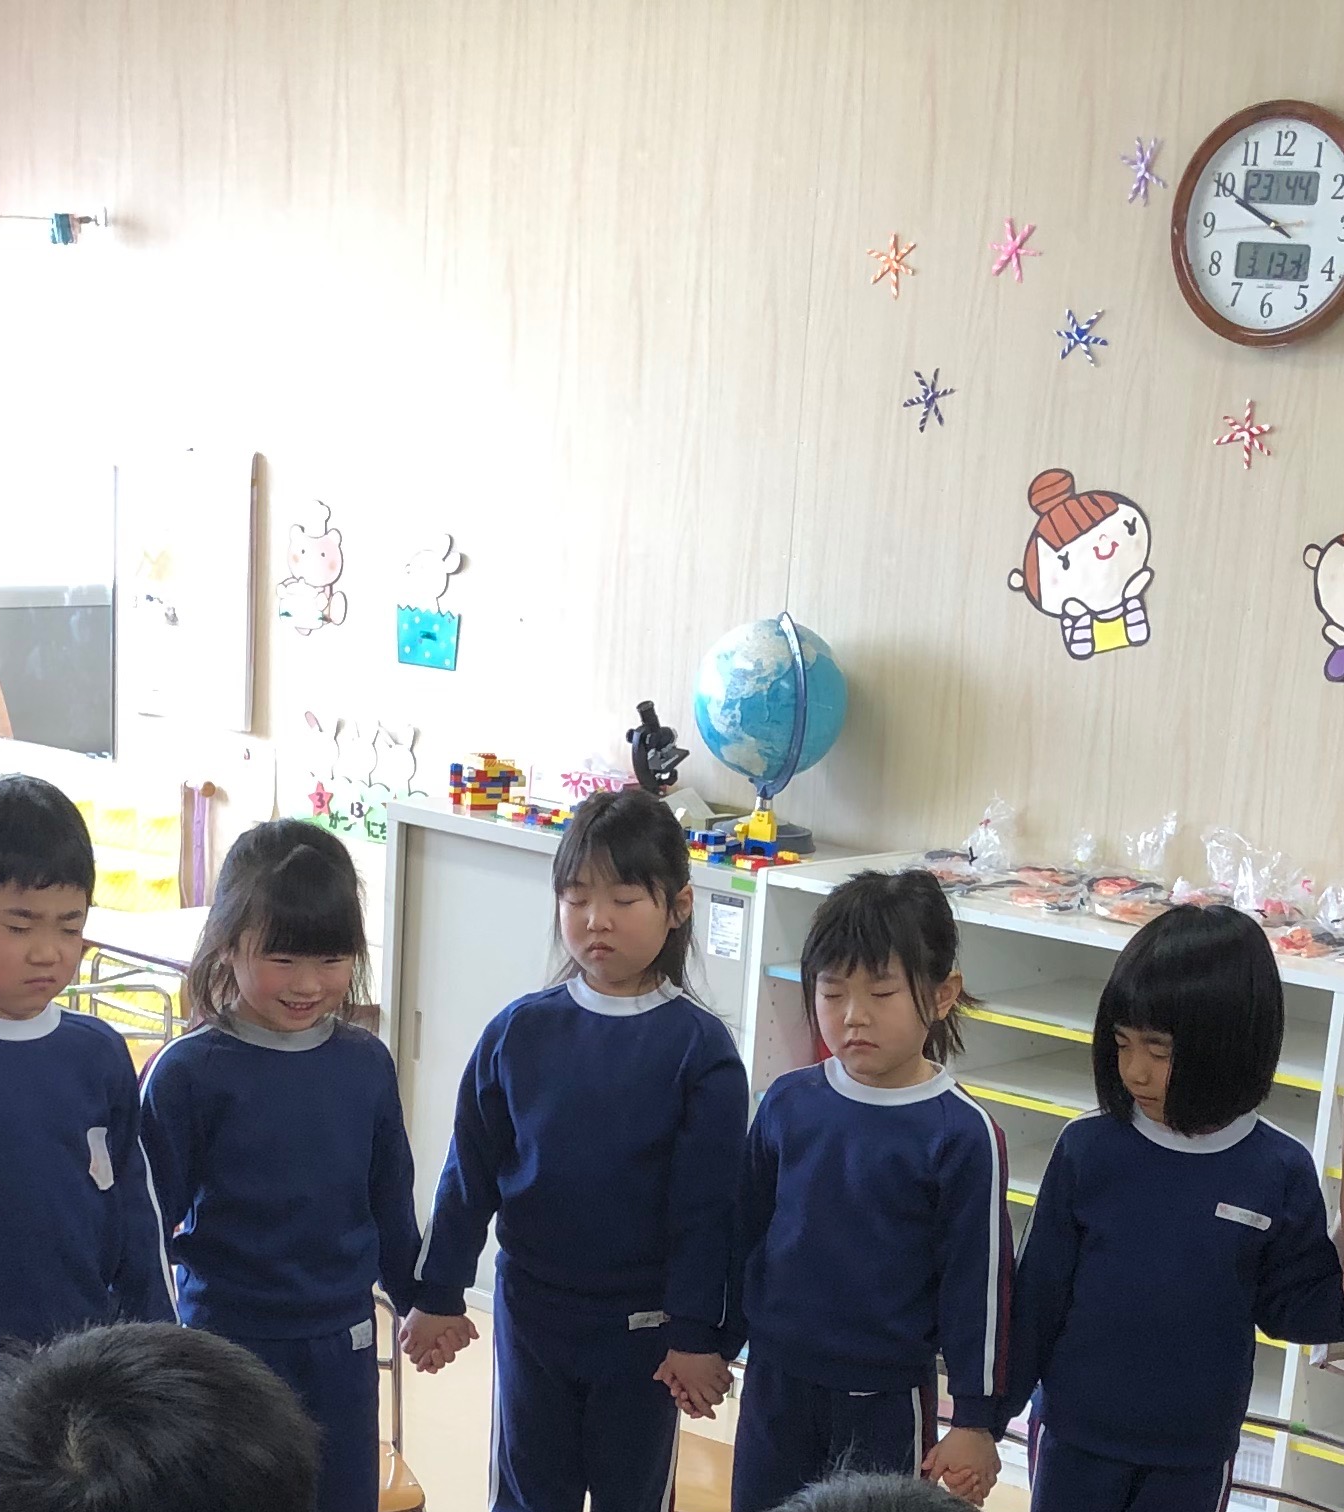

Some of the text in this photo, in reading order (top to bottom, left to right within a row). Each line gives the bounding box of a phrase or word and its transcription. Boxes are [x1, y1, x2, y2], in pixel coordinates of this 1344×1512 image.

[1241, 141, 1259, 167] 11
[1274, 130, 1298, 157] 12
[1314, 142, 1323, 167] 1
[1213, 171, 1236, 198] 10
[1246, 173, 1312, 201] 23 44
[1202, 212, 1216, 238] 9
[1208, 251, 1222, 276] 8
[1321, 256, 1336, 282] 4
[1230, 282, 1243, 307] 7
[1260, 292, 1272, 318] 6
[1294, 285, 1309, 310] 5
[316, 792, 325, 809] 3
[350, 802, 364, 818] 13
